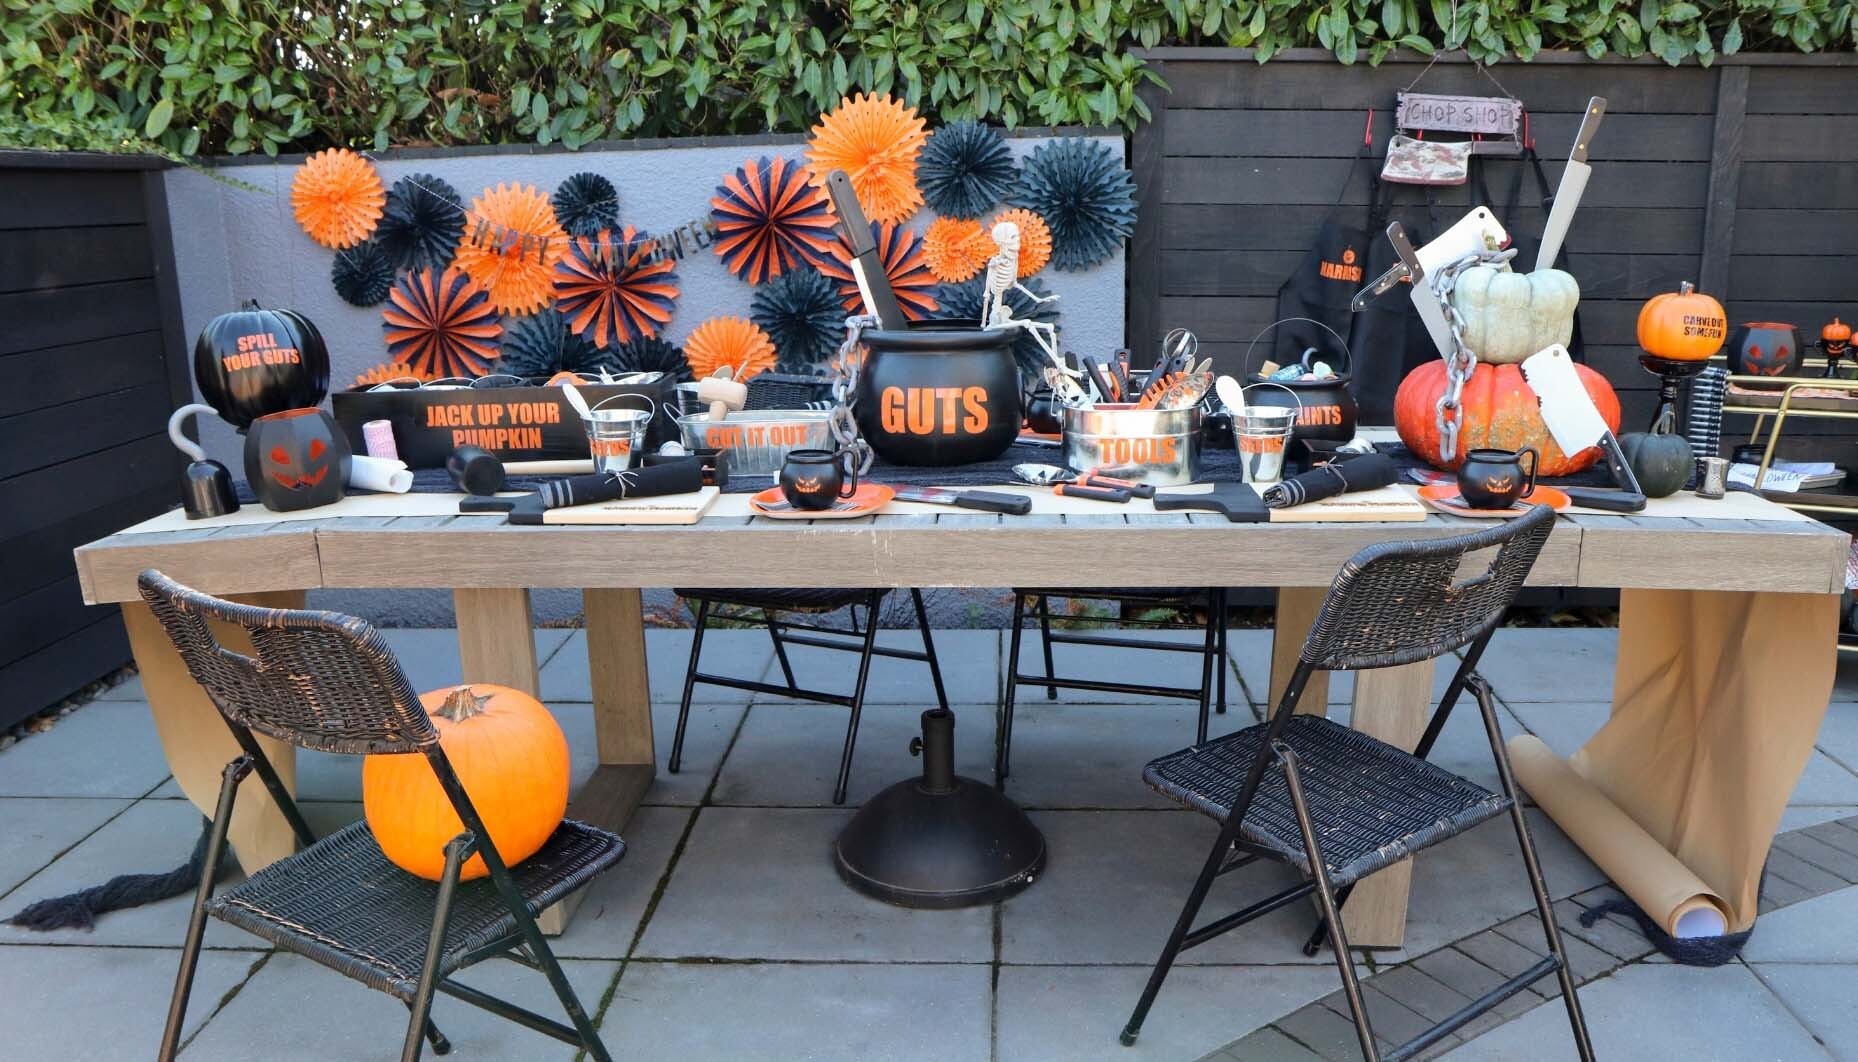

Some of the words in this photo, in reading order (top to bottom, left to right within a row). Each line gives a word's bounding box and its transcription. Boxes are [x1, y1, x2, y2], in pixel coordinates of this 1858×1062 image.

[1410, 102, 1456, 124] CHOP
[1463, 106, 1513, 126] SHOP
[471, 216, 549, 266] HAPPY
[238, 332, 277, 352] SPILL
[223, 350, 261, 373] YOUR
[263, 348, 300, 366] GUTS
[426, 404, 475, 427] JACK
[477, 403, 504, 426] UP
[507, 402, 561, 425] YOUR
[881, 386, 989, 434] GUTS
[1295, 404, 1342, 426] AINTS
[452, 427, 543, 449] PUMPKIN
[705, 426, 743, 449] CUT
[748, 426, 766, 448] IT
[769, 424, 808, 447] OUT
[1099, 436, 1176, 465] TOOLS
